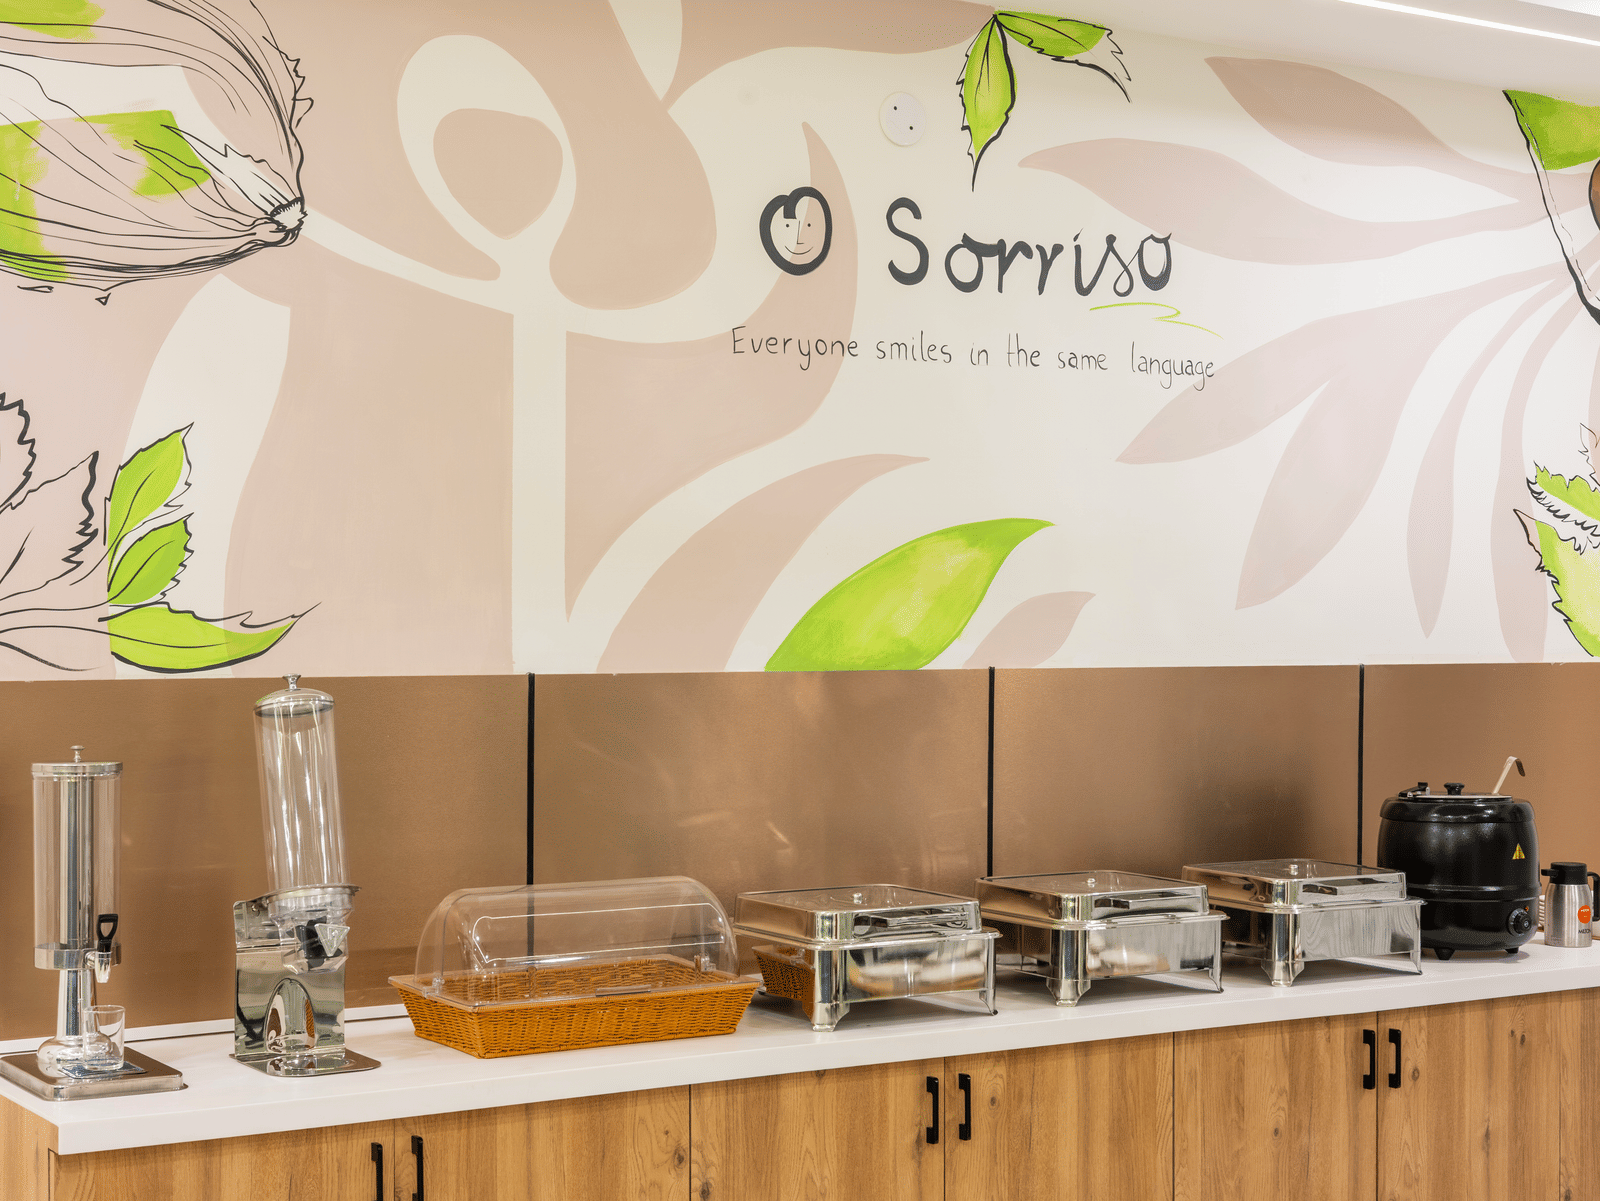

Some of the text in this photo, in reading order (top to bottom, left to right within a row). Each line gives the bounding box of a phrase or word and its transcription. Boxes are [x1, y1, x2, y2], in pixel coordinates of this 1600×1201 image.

[759, 186, 1173, 298] O Sorriso
[731, 325, 1216, 392] Everyone smiles in the same language
